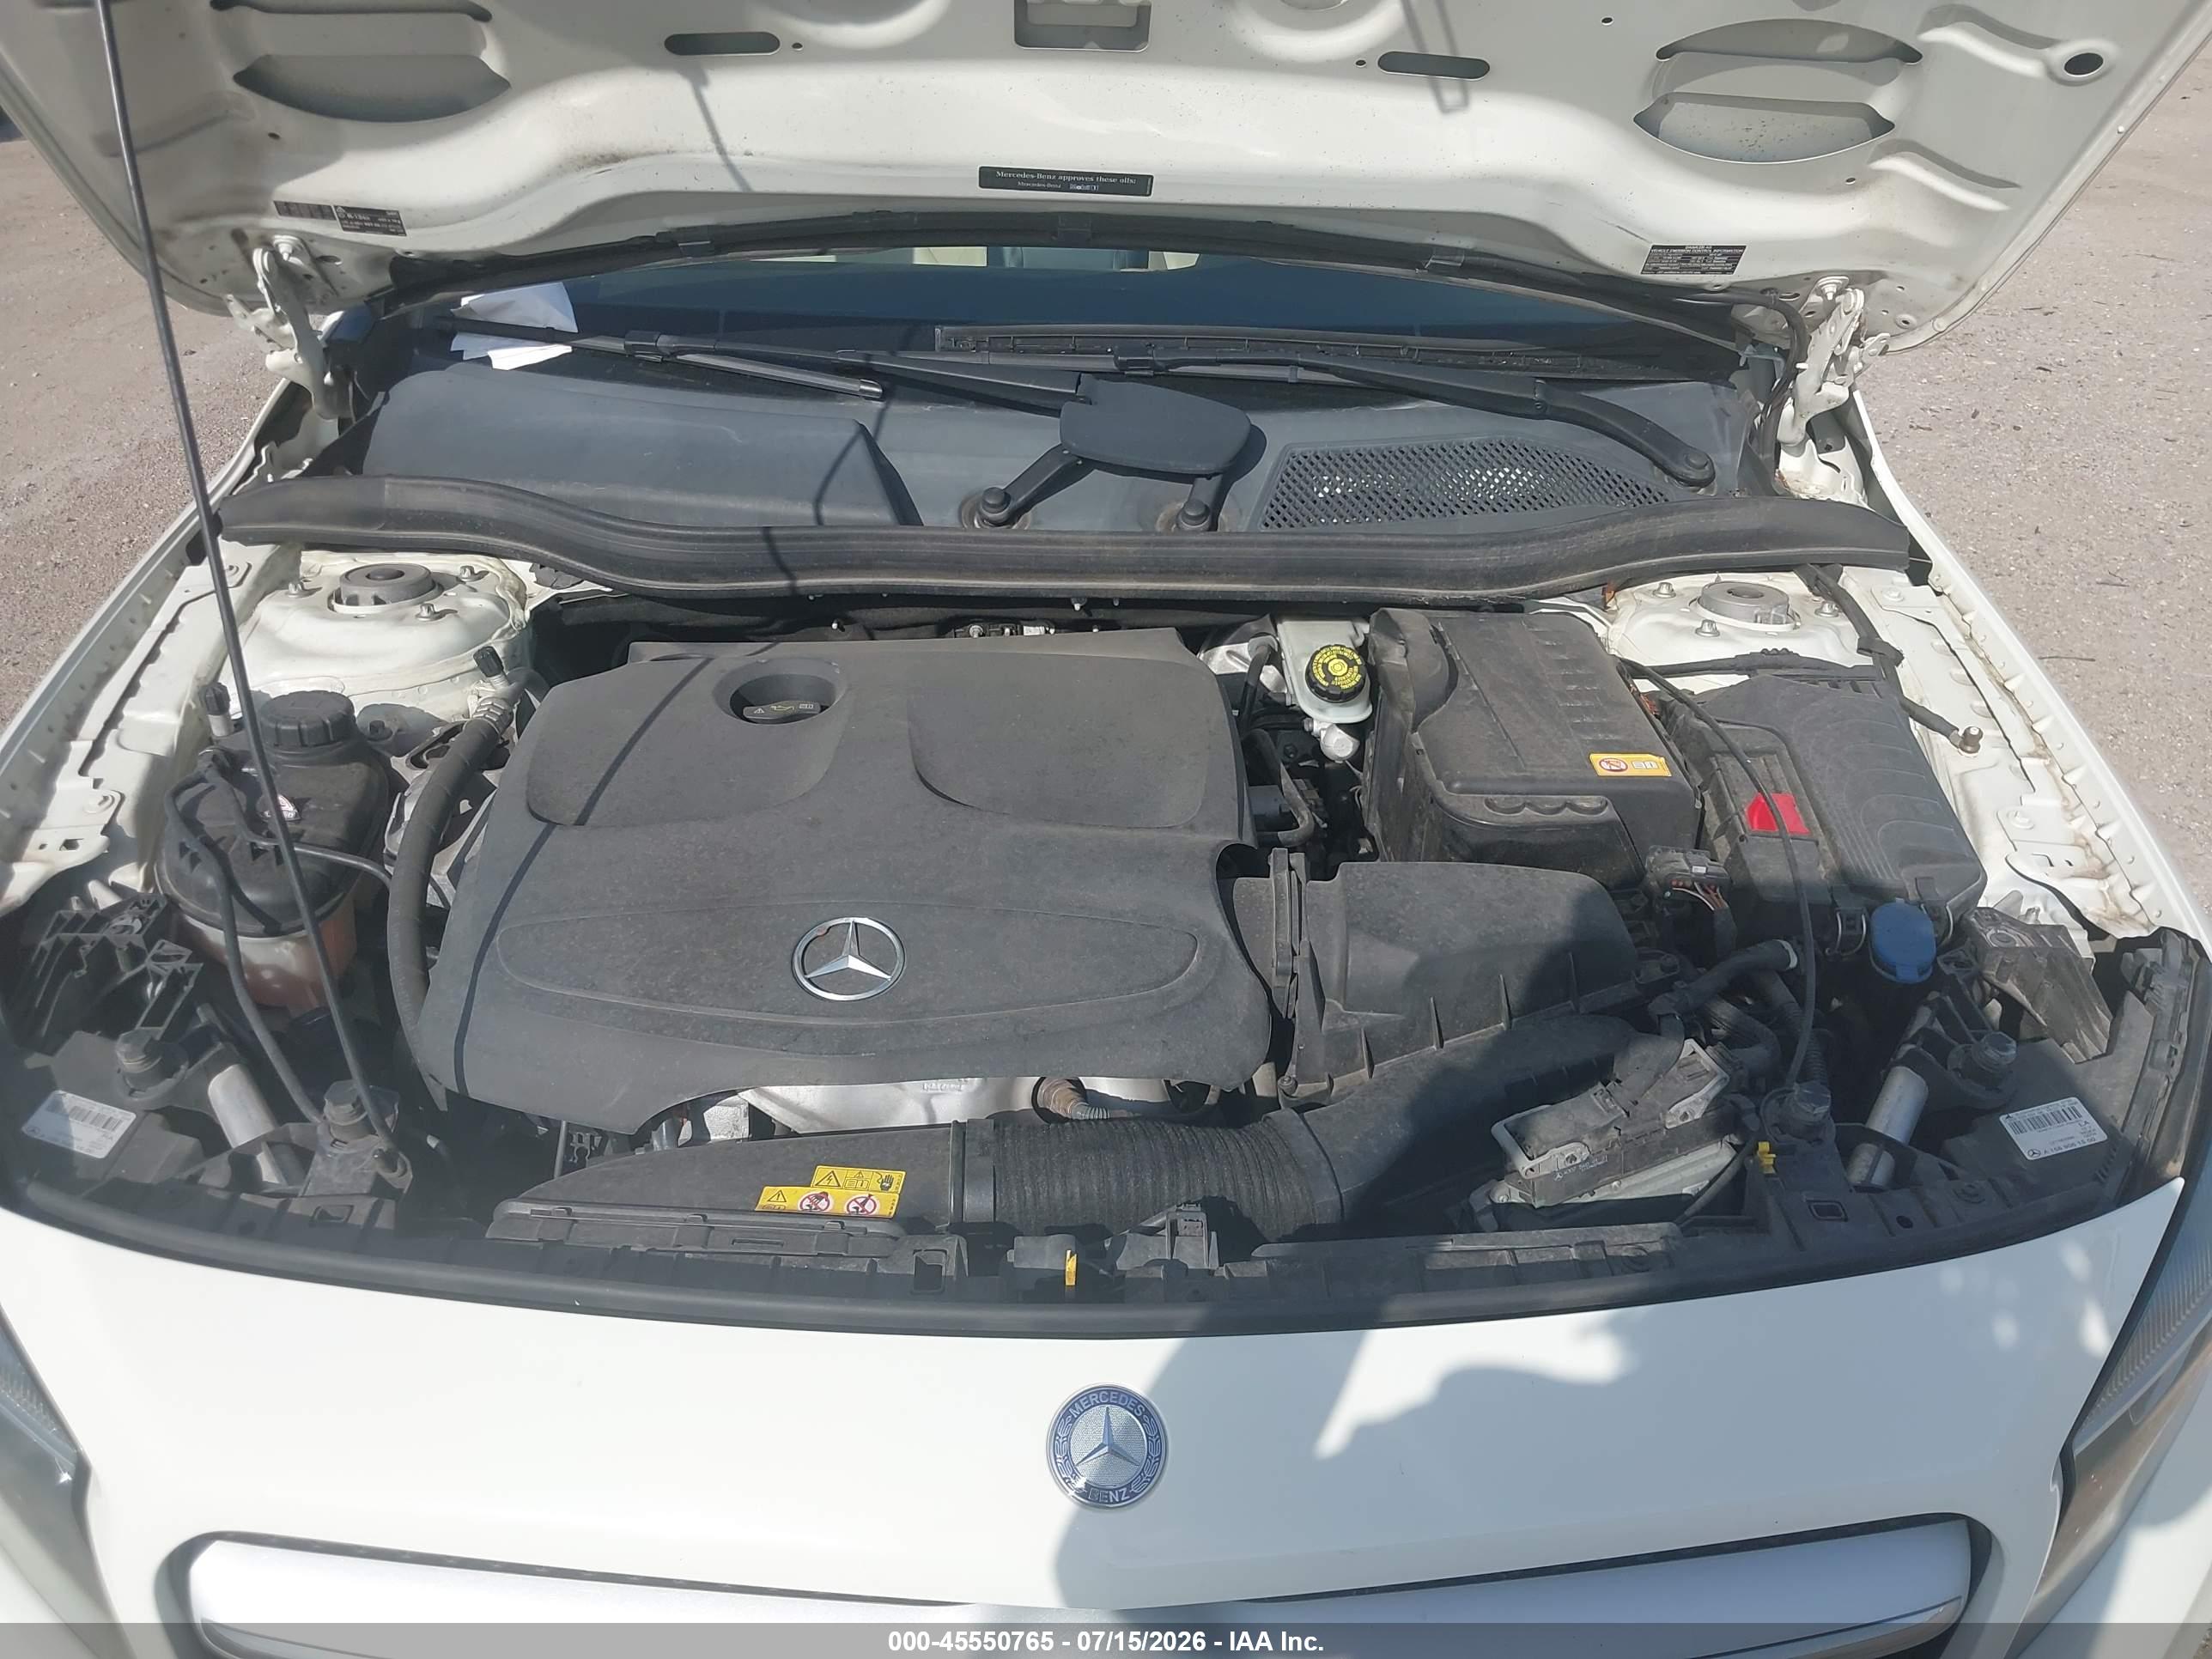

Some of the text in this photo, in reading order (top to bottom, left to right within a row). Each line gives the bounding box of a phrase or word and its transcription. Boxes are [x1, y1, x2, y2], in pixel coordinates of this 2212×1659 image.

[996, 171, 1056, 180] Mercedes-Benz
[1069, 1391, 1146, 1418] MERCEDES
[1088, 1487, 1130, 1503] BENZ
